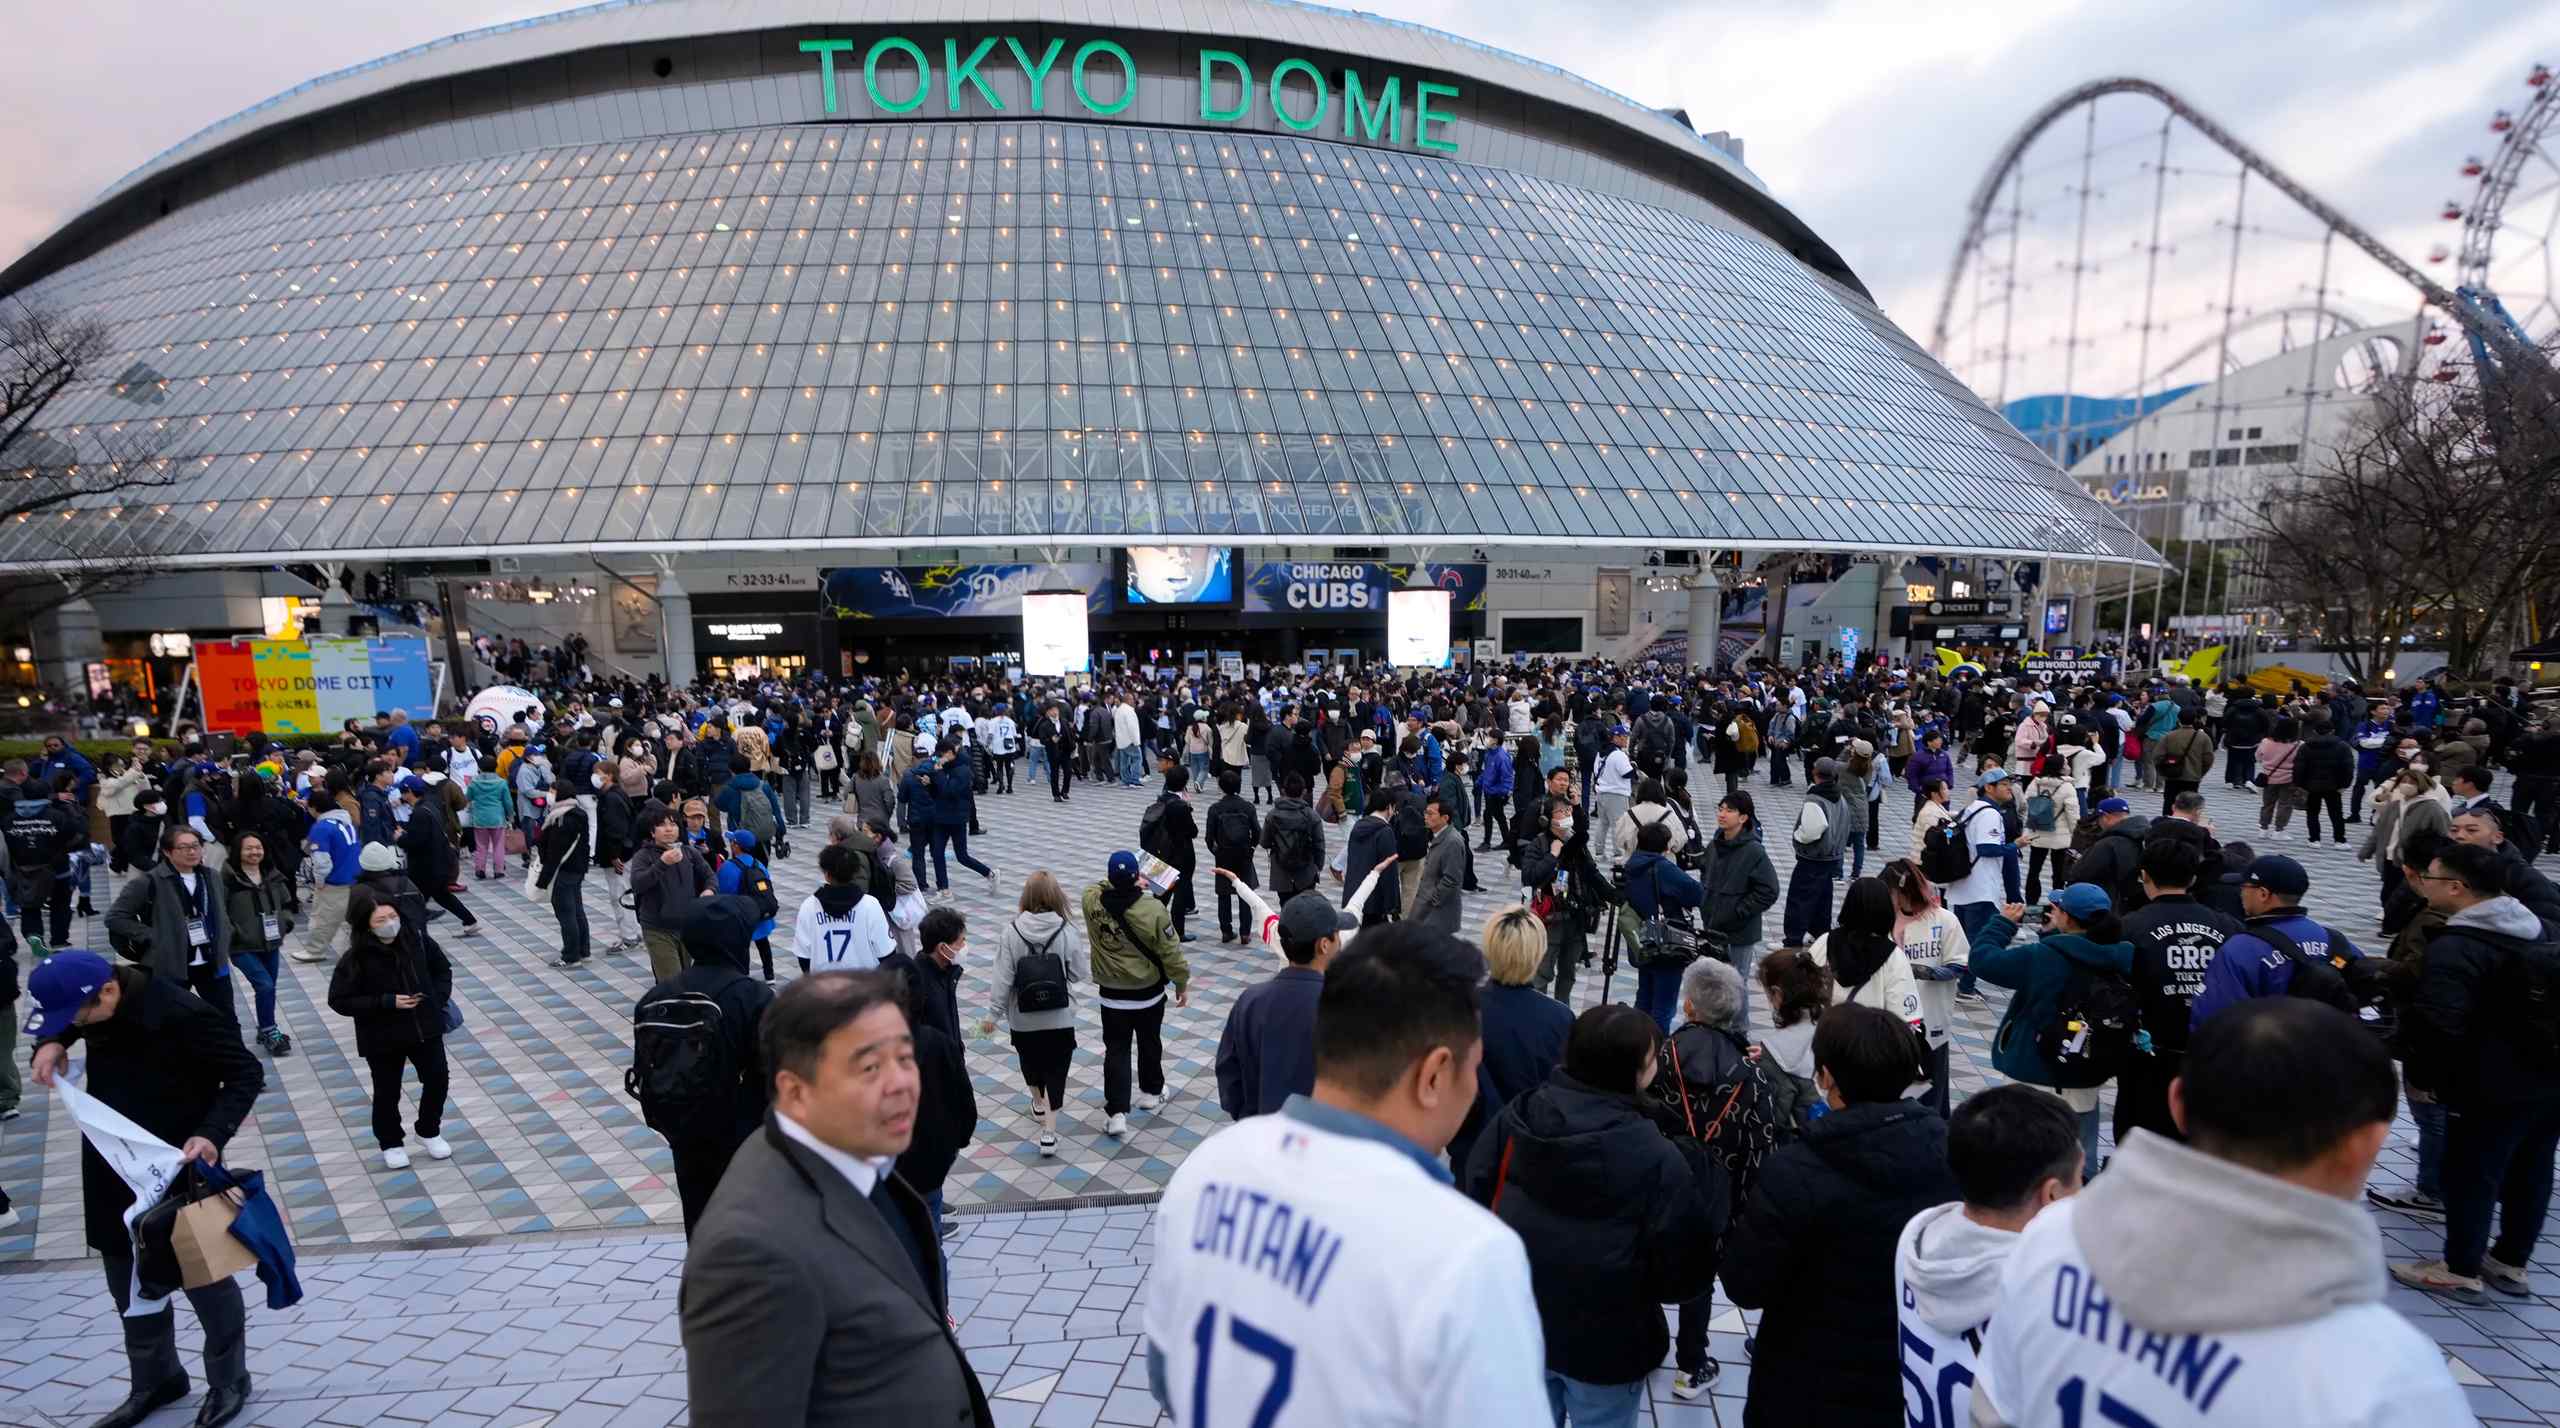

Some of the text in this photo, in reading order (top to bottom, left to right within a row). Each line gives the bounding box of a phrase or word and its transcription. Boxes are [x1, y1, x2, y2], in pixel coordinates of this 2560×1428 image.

[798, 36, 1460, 153] TOKYO DOME
[1292, 564, 1364, 580] CHICAGO
[1287, 582, 1368, 609] CUBS
[1944, 602, 1980, 613] TICKETS
[2027, 660, 2101, 669] MLB WORLD TOUR
[232, 675, 395, 691] TOKYO DOME CITY
[2150, 922, 2225, 944] LOS ANGELES
[823, 929, 852, 962] 17
[1903, 941, 1942, 961] NGELES
[1191, 1182, 1344, 1307] OHTANI
[1191, 1302, 1297, 1428] 17
